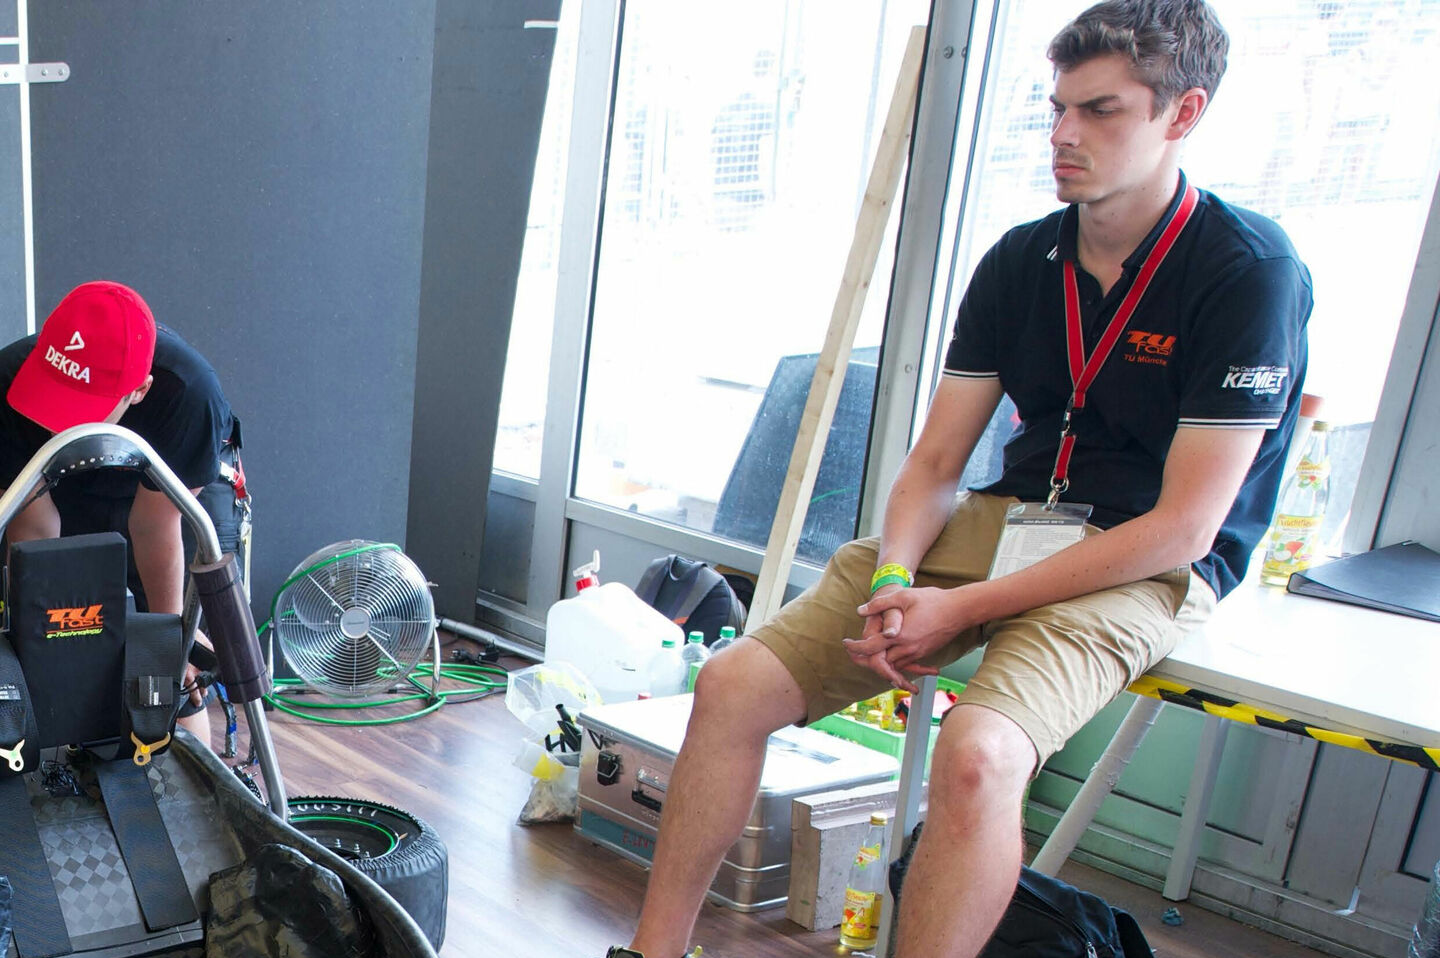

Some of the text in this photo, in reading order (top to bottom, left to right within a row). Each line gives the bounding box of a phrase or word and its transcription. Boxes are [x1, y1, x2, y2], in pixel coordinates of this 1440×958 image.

[44, 345, 91, 384] DEKRA
[1221, 371, 1288, 389] KEMET
[46, 604, 104, 623] TU
[60, 615, 104, 629] fast
